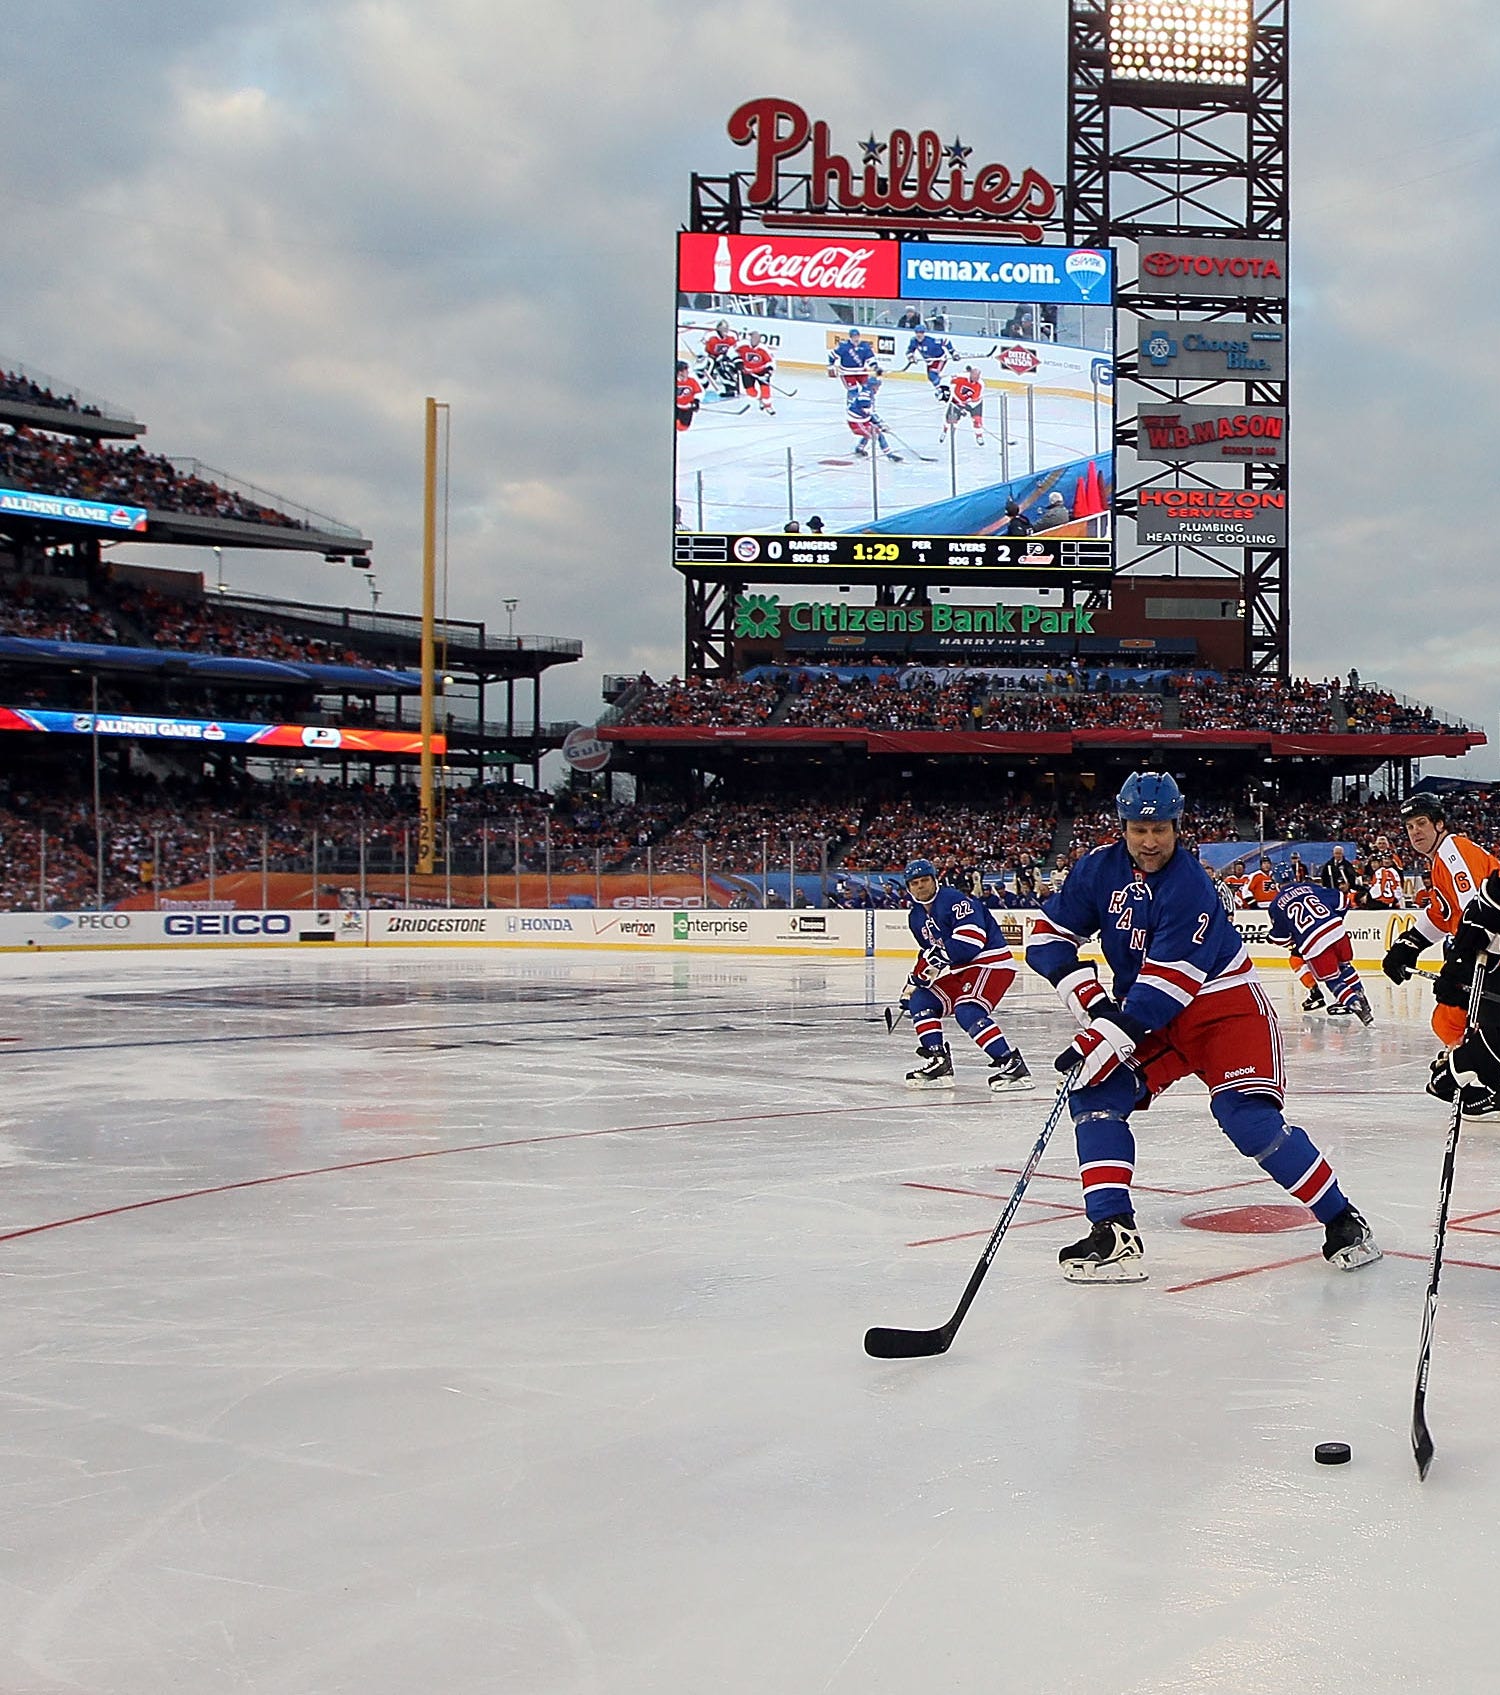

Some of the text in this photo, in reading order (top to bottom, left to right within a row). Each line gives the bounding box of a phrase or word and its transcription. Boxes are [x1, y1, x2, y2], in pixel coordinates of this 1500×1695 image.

[727, 97, 1057, 217] Phillies
[738, 244, 876, 290] Coca-Cola
[1179, 255, 1282, 280] TOYOTA
[878, 338, 895, 352] CAT
[1183, 333, 1250, 354] Choose
[1139, 490, 1285, 508] HORIZON
[63, 504, 108, 521] GAME
[1167, 508, 1255, 519] SERVICES
[1179, 523, 1244, 533] PLUMBING
[788, 540, 838, 551] RANGERS
[912, 541, 932, 550] PER
[1146, 533, 1277, 544] HEATING COOLING
[767, 541, 783, 559] 0
[853, 543, 900, 561] 1:29
[949, 543, 986, 553] FLYERS
[997, 545, 1011, 562] 2
[792, 554, 830, 564] SOG 15
[918, 553, 926, 563] 1
[949, 556, 969, 566] SOG
[788, 602, 1096, 634] Citizens Bank Park
[940, 638, 994, 646] HARRY
[1019, 639, 1046, 647] K'S
[96, 719, 202, 737] ALUMNI GAME
[1454, 871, 1471, 893] 6
[612, 895, 703, 909] GEICO
[952, 900, 975, 920] 22
[78, 914, 131, 929] PECO
[1287, 894, 1330, 934] 26
[164, 914, 291, 936] GEICO
[387, 917, 487, 933] BRIDGESTONE
[521, 918, 573, 931] HONDA
[620, 919, 656, 937] verizon
[678, 918, 748, 936] enterprise
[866, 910, 874, 949] Reebok
[1108, 890, 1147, 966] RAN
[1192, 913, 1210, 945] 2
[1347, 929, 1380, 941] ovin' it
[1224, 1065, 1256, 1080] Reebok
[986, 1193, 1022, 1264] MONTREAL
